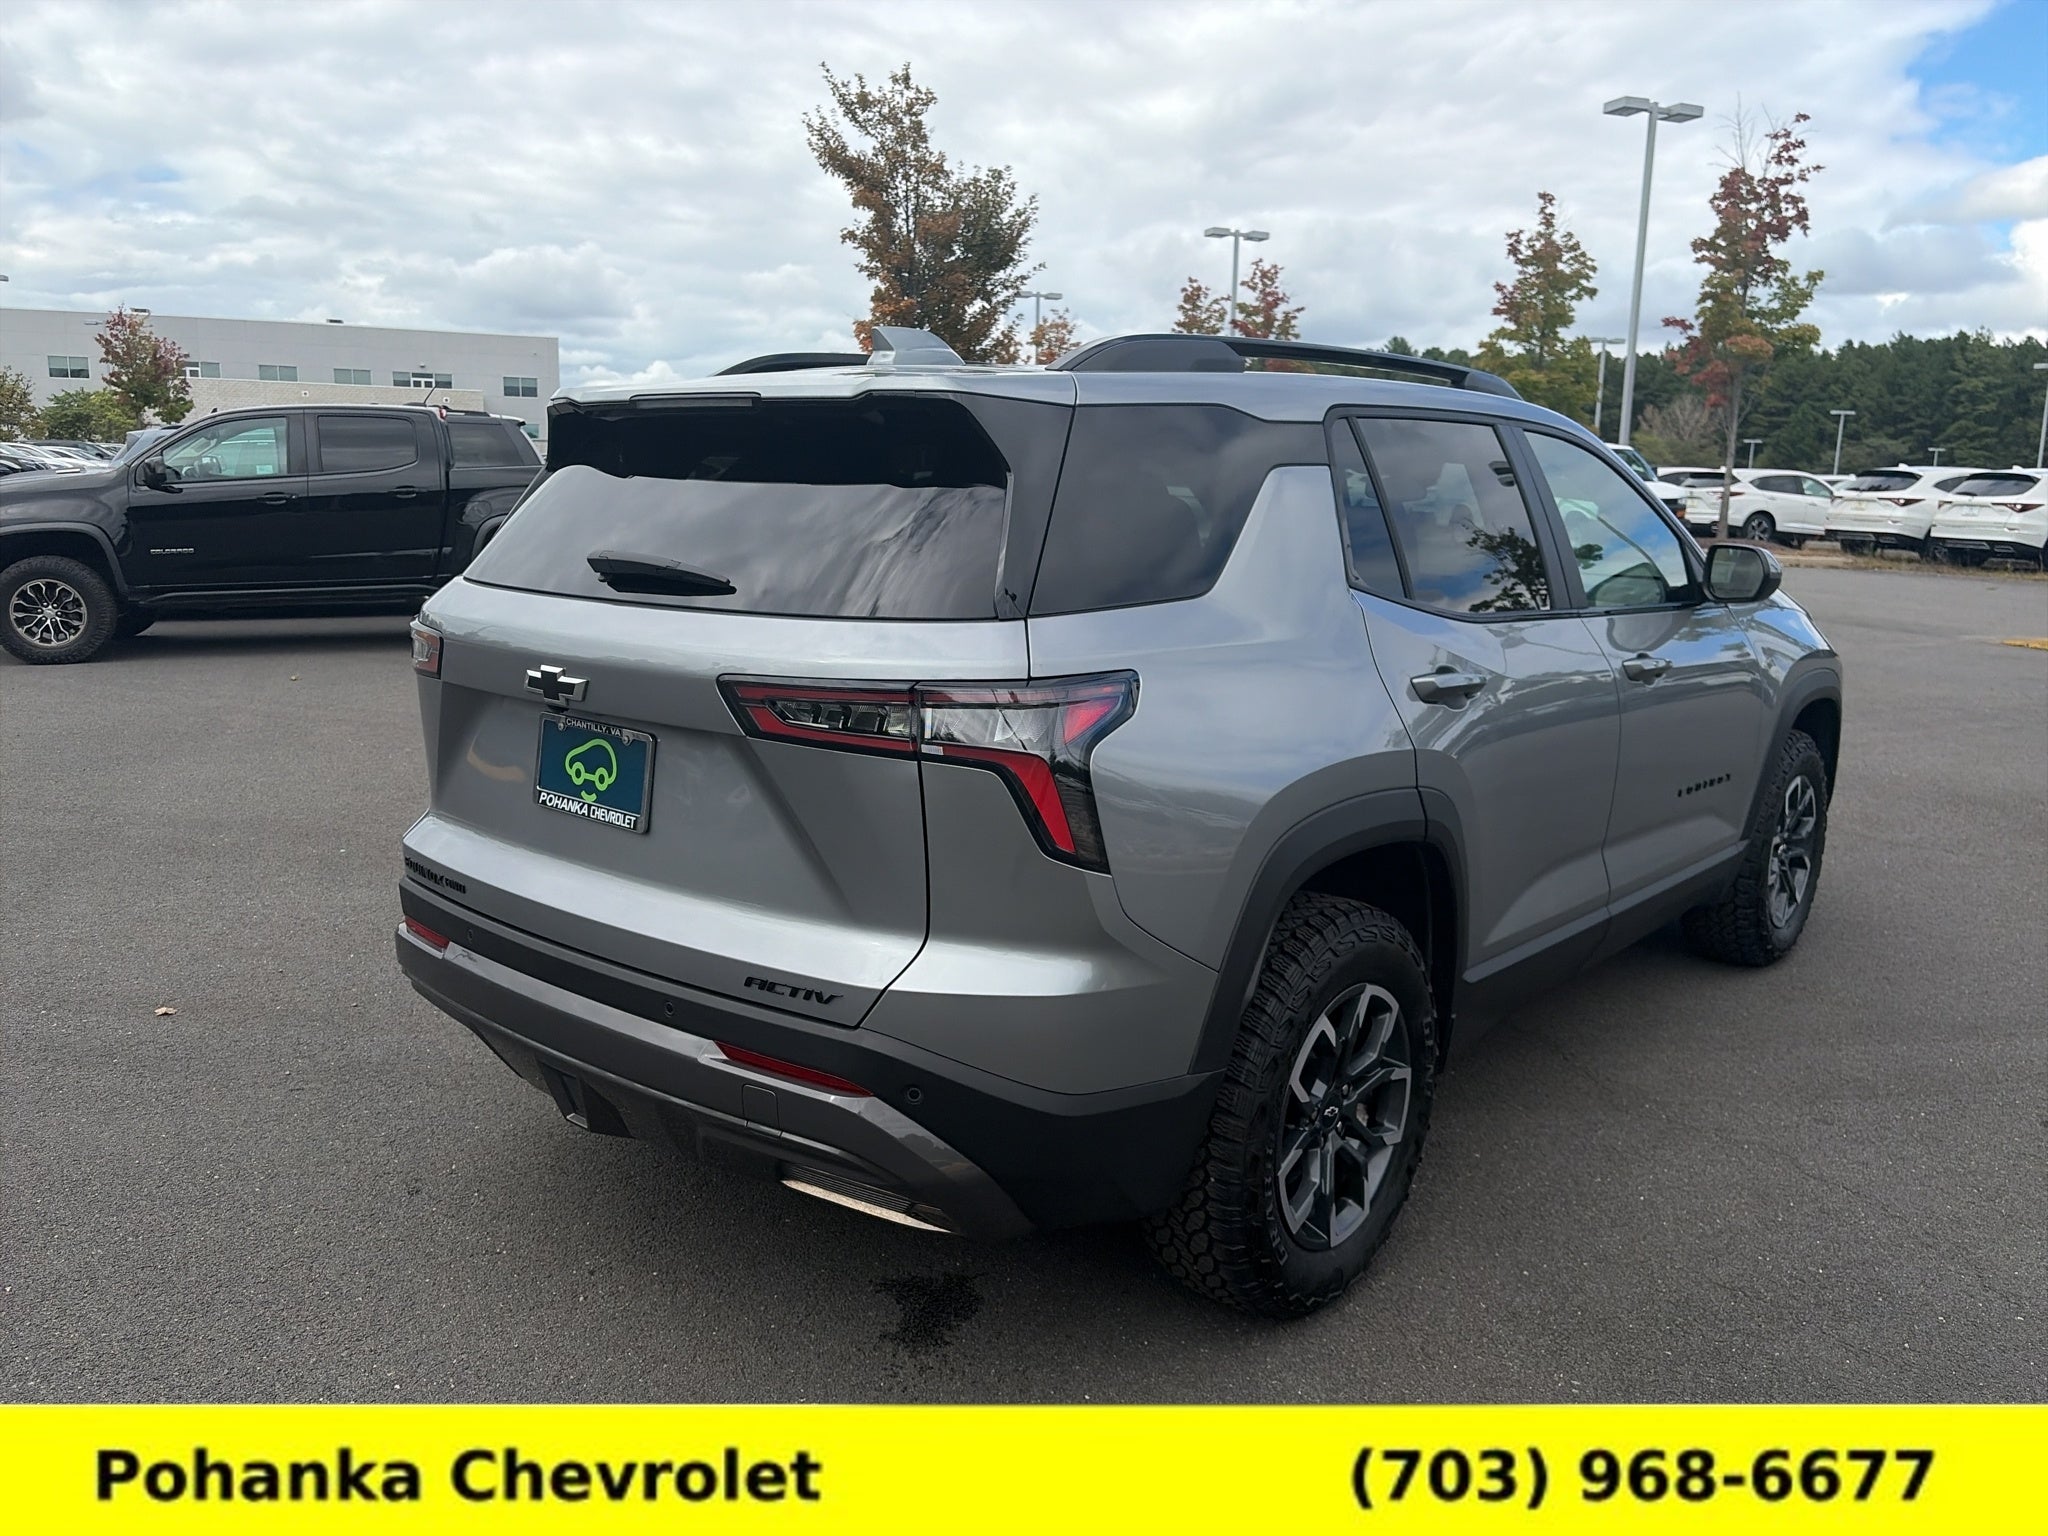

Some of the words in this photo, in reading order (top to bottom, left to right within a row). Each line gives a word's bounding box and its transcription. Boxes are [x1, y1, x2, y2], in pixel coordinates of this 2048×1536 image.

[610, 727, 622, 737] VA
[538, 792, 589, 816] POHANKA
[589, 804, 637, 829] CHEVROLET
[743, 976, 844, 1005] ACTIV
